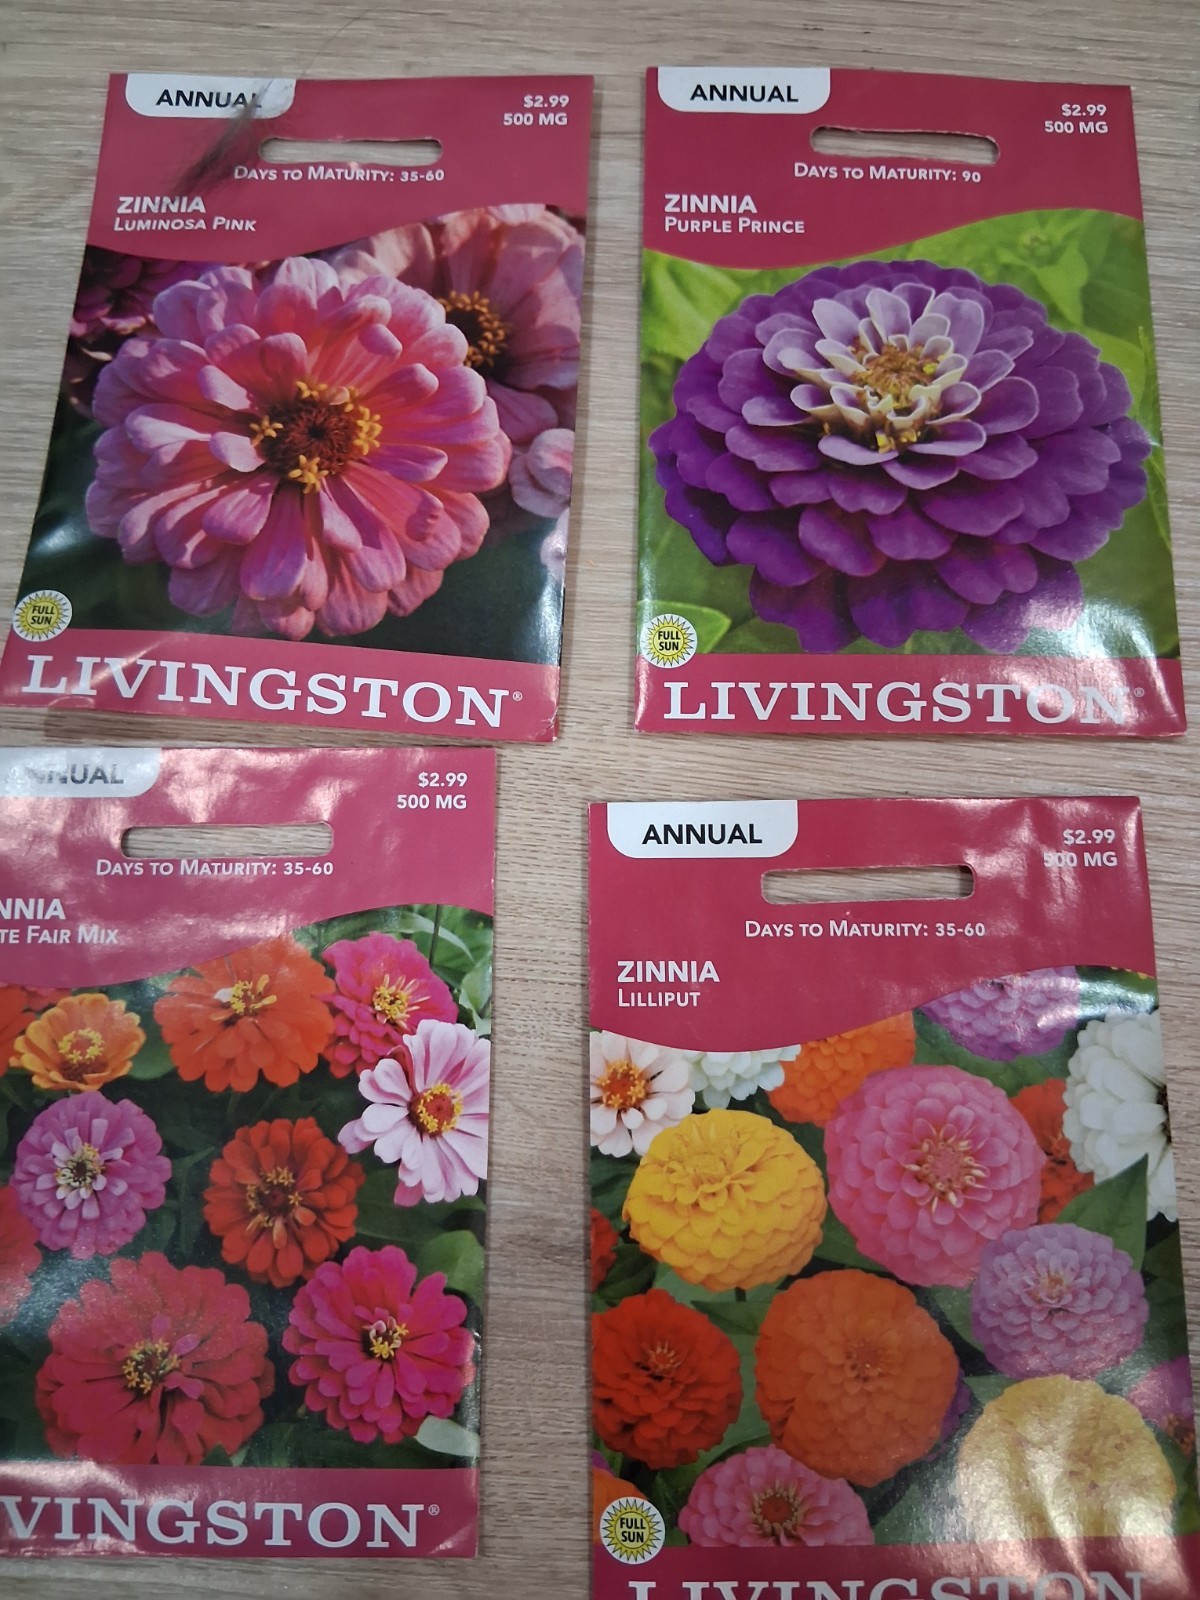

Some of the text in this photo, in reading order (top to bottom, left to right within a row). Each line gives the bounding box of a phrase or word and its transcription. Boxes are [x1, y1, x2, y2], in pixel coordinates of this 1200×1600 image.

[156, 89, 262, 108] ANNUAL
[523, 95, 570, 108] $2.99
[690, 84, 799, 102] ANNUAL
[1061, 103, 1107, 117] $2.99
[503, 113, 568, 126] 500 MG
[1044, 120, 1109, 134] 500 MG
[234, 165, 445, 182] DAYS TO MATURITY: 35-60
[793, 162, 981, 183] DAYS TO MATURITY: 90
[116, 196, 206, 214] ZINNIA
[664, 194, 758, 214] ZINNIA
[114, 216, 257, 232] LUMINOSA PINK
[664, 216, 805, 234] PURPLE PRINCE
[32, 606, 55, 614] FULL
[30, 616, 52, 625] SUN
[658, 630, 681, 640] FULL
[658, 641, 679, 651] SUN
[22, 763, 125, 785] NNUAL
[418, 772, 468, 788] $2.99
[396, 794, 468, 810] 500 MG
[642, 823, 762, 845] ANNUAL
[1063, 828, 1116, 846] $2.99
[96, 859, 334, 876] DAYS TO MATURITY: 35-60
[1043, 851, 1118, 868] 500 MG
[26, 925, 71, 944] FAIR
[77, 925, 120, 945] MIX
[745, 920, 986, 937] DAYS TO MATURITY: 35-60
[617, 960, 720, 983] ZINNIA
[618, 988, 701, 1008] LILLIPUT
[620, 1517, 646, 1530] FULL
[621, 1530, 644, 1542] SUN
